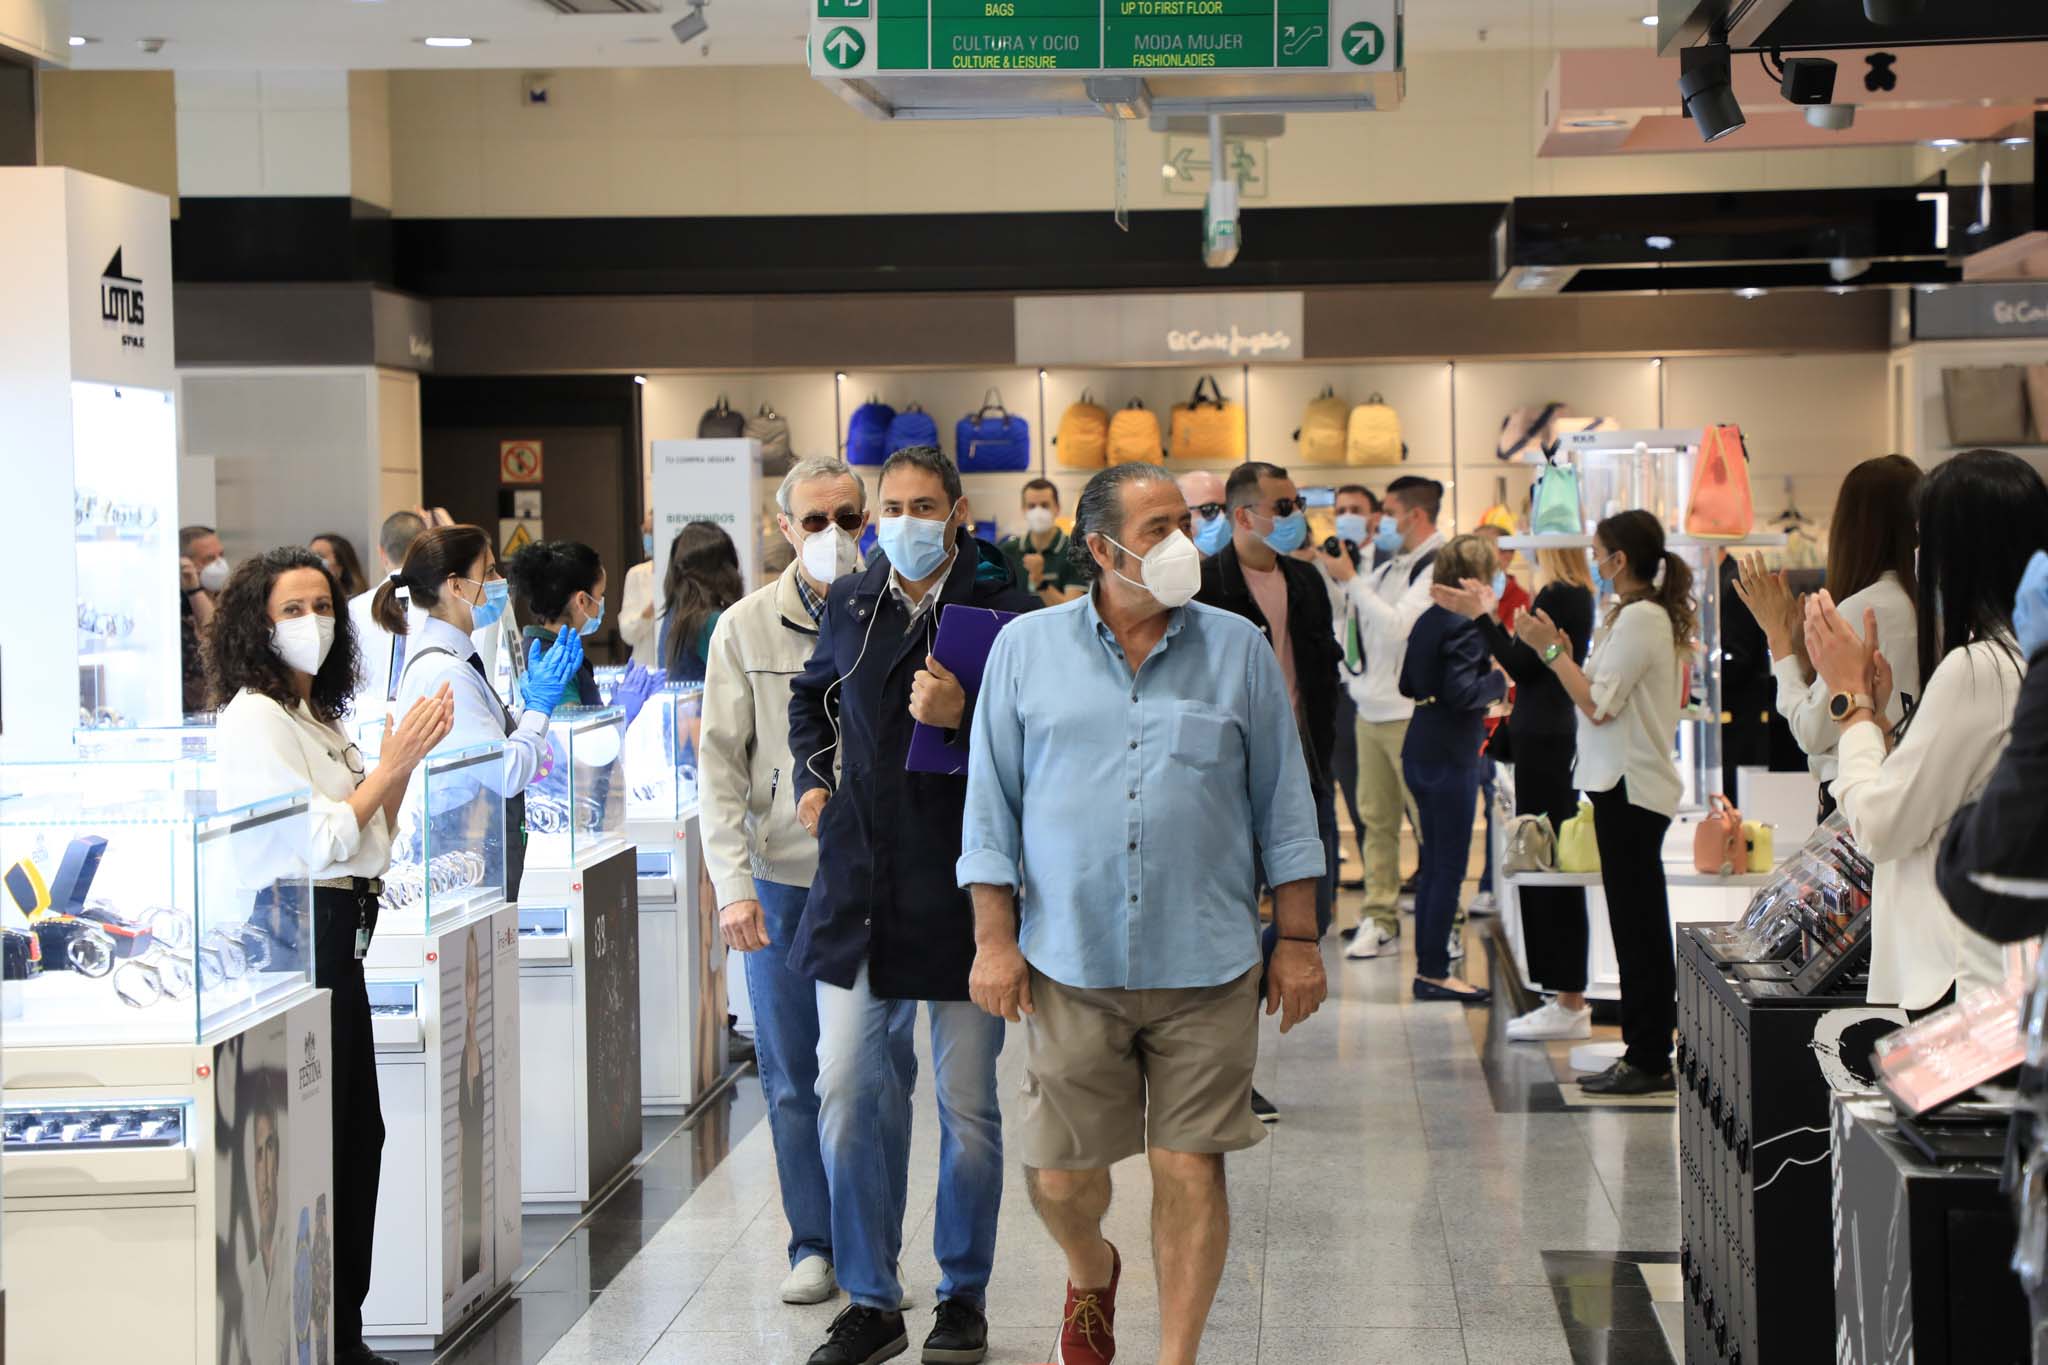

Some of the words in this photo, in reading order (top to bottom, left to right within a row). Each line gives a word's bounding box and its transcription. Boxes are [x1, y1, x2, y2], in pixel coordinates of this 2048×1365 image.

[985, 3, 1015, 17] BAGS
[1121, 2, 1136, 16] UP
[1137, 2, 1152, 15] TO
[1154, 2, 1186, 15] FIRST
[1187, 1, 1223, 15] FLOOR
[952, 35, 1024, 51] CULTURA
[1028, 35, 1037, 51] Y
[1042, 35, 1080, 51] OCIO
[1134, 34, 1183, 50] MODA
[1188, 34, 1243, 50] MUJER
[952, 55, 1001, 69] CULTURE
[1003, 55, 1010, 68] &
[1012, 55, 1057, 68] LEISURE
[101, 284, 144, 326] LOTUS
[121, 335, 145, 348] STYLE
[298, 1059, 321, 1090] FESTINA
